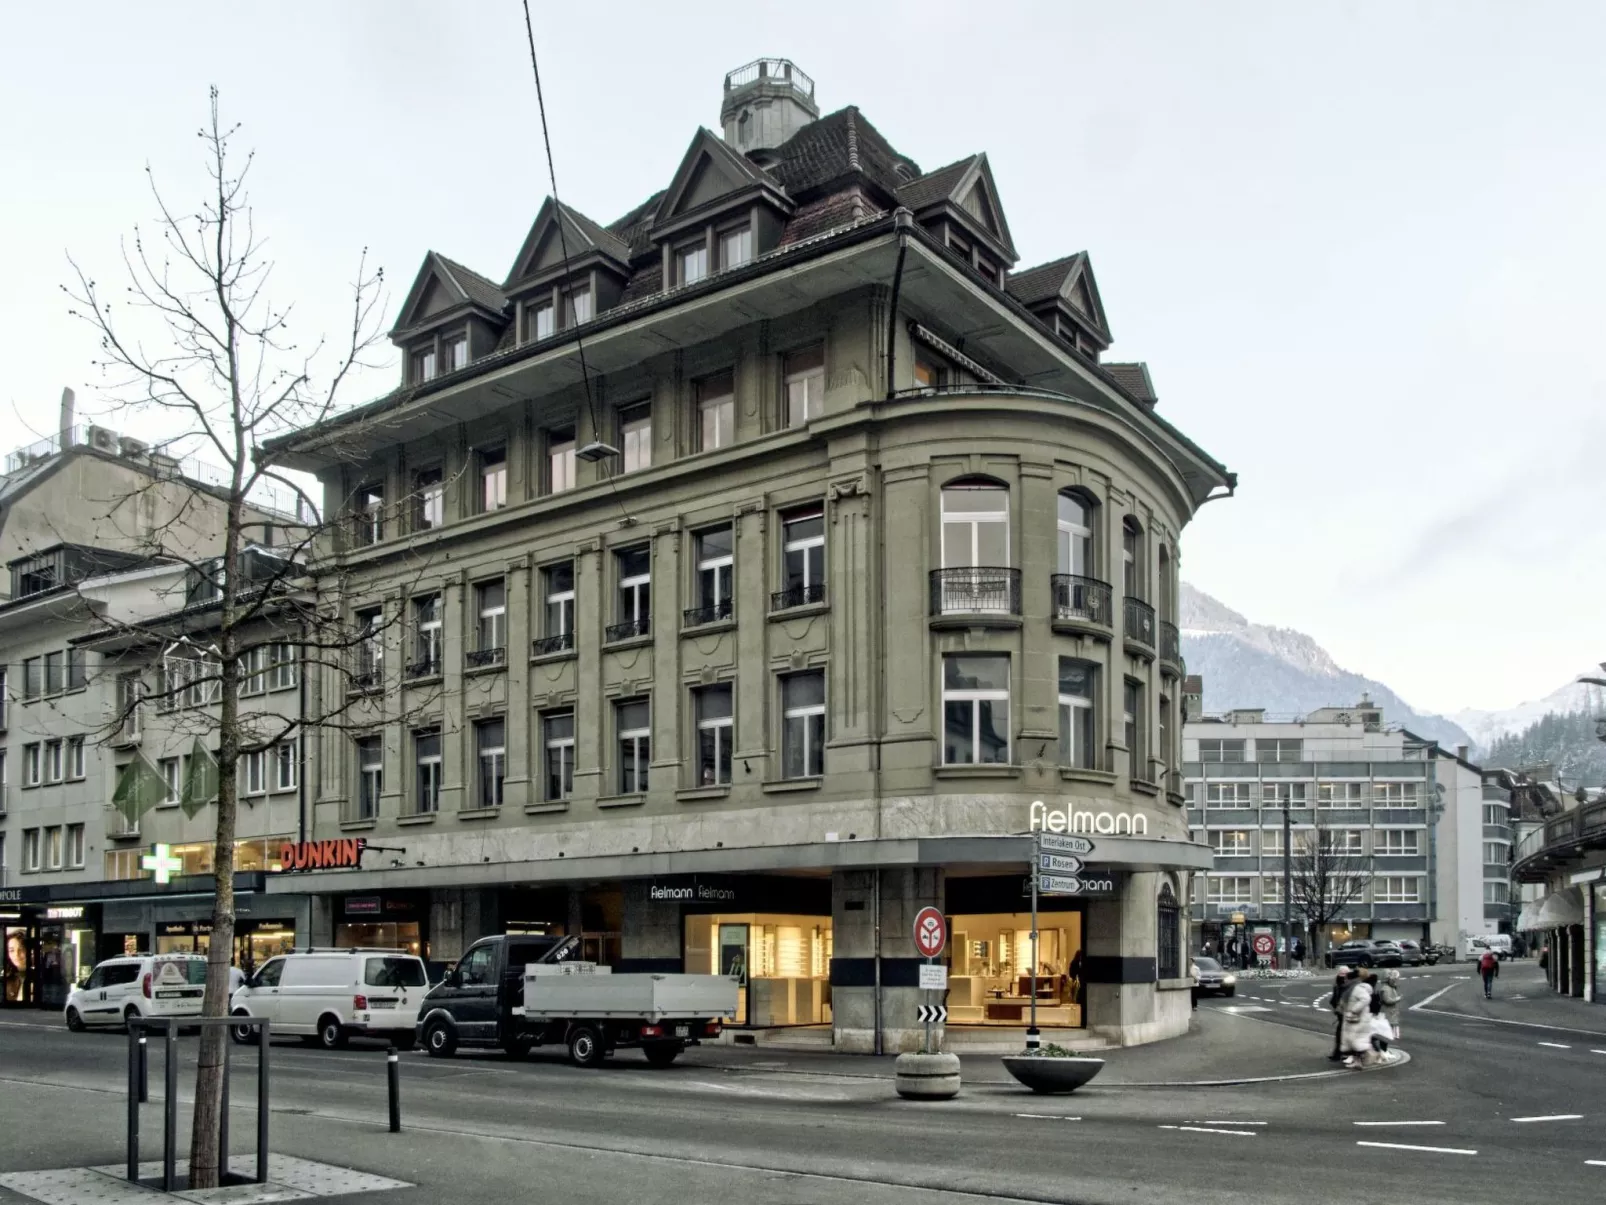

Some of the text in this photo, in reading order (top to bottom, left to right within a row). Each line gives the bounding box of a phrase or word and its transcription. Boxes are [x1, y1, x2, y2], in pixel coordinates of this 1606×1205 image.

[1029, 800, 1148, 835] fielmann
[1043, 836, 1086, 851] Interlaken Ost
[1052, 857, 1074, 871] Rosen
[1051, 879, 1076, 890] Zentrum
[0, 890, 22, 901] POLE
[651, 885, 693, 899] fielmann
[698, 884, 735, 900] fielmann
